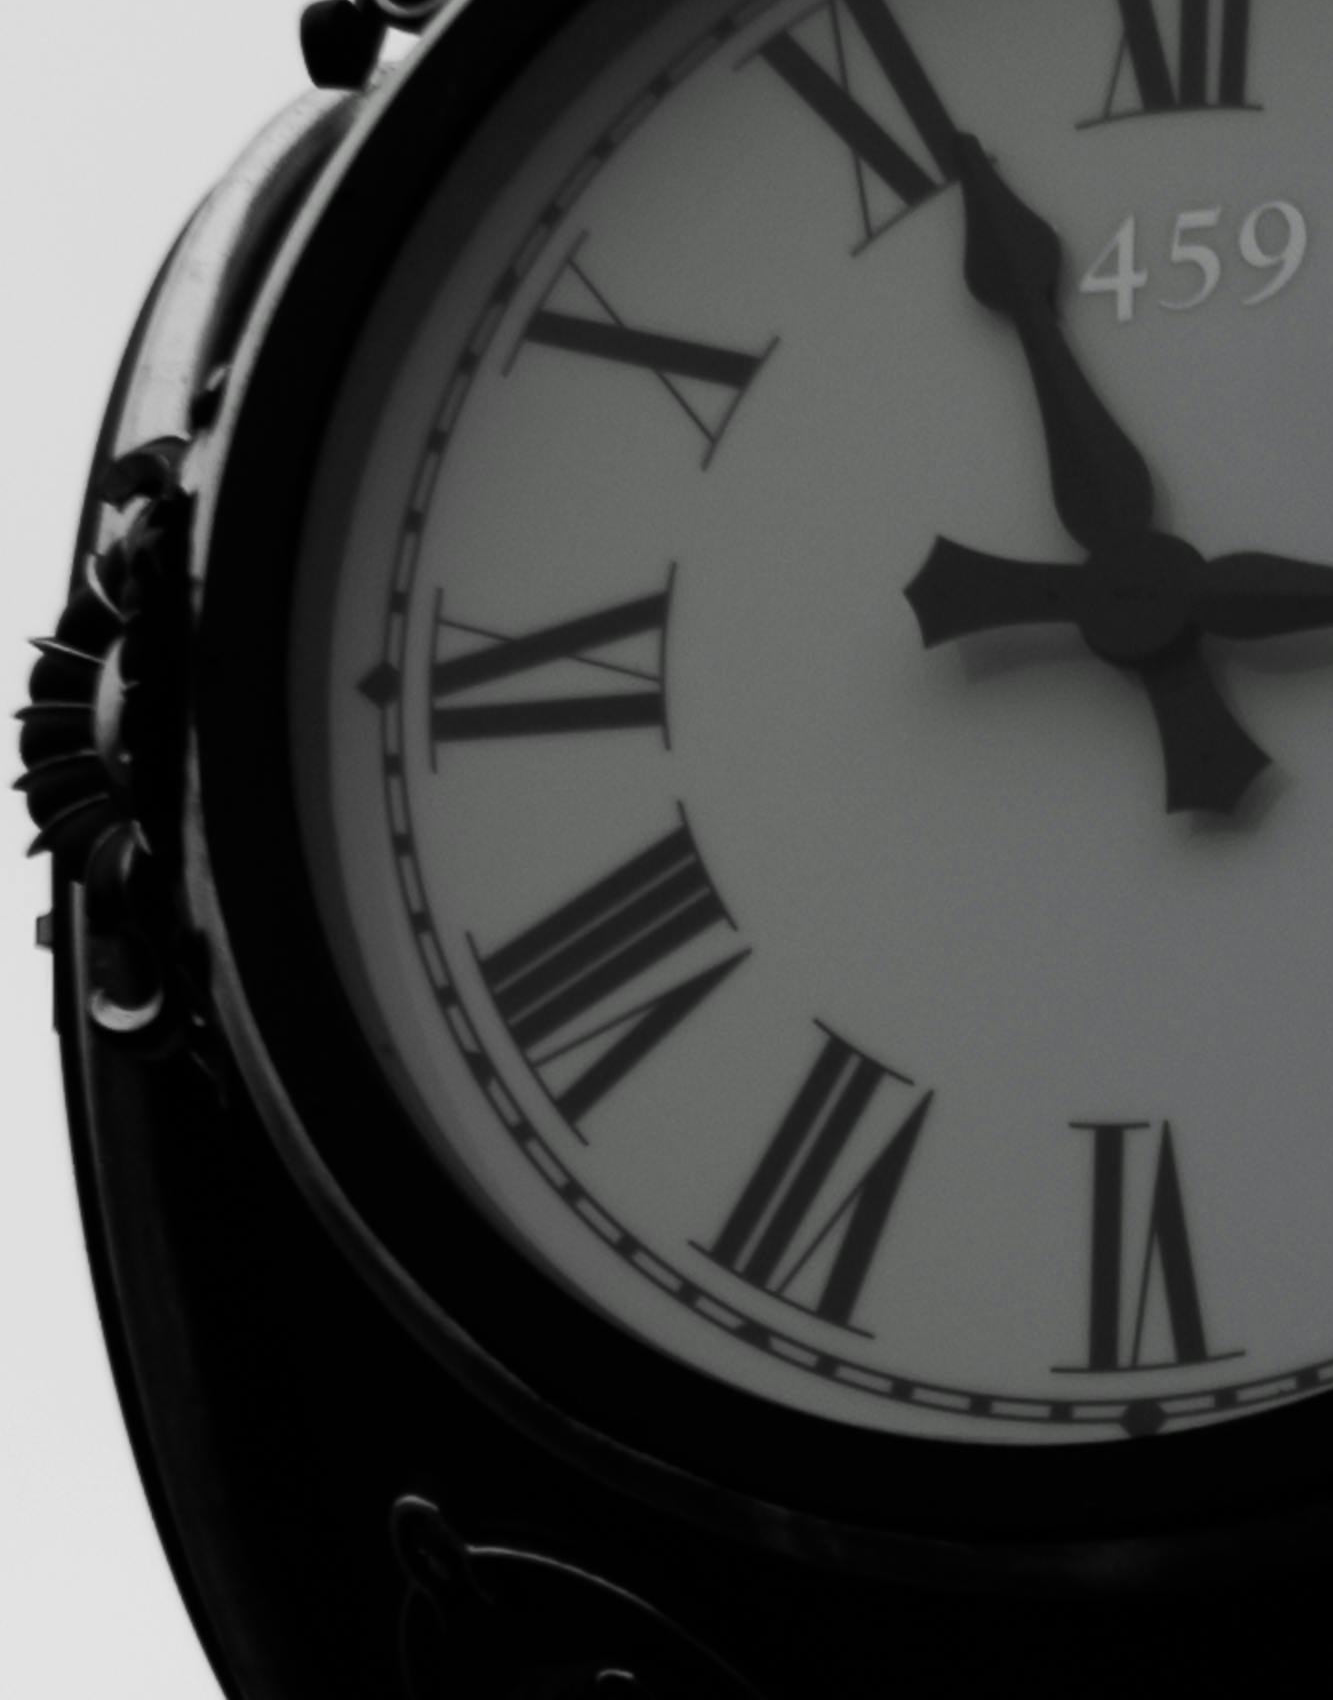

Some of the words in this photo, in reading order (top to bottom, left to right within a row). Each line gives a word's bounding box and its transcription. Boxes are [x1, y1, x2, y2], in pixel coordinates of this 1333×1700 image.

[501, 230, 782, 472] X
[1078, 194, 1314, 324] 459
[430, 558, 678, 773] IX
[687, 1017, 938, 1342] VII
[1049, 1117, 1248, 1374] VI
